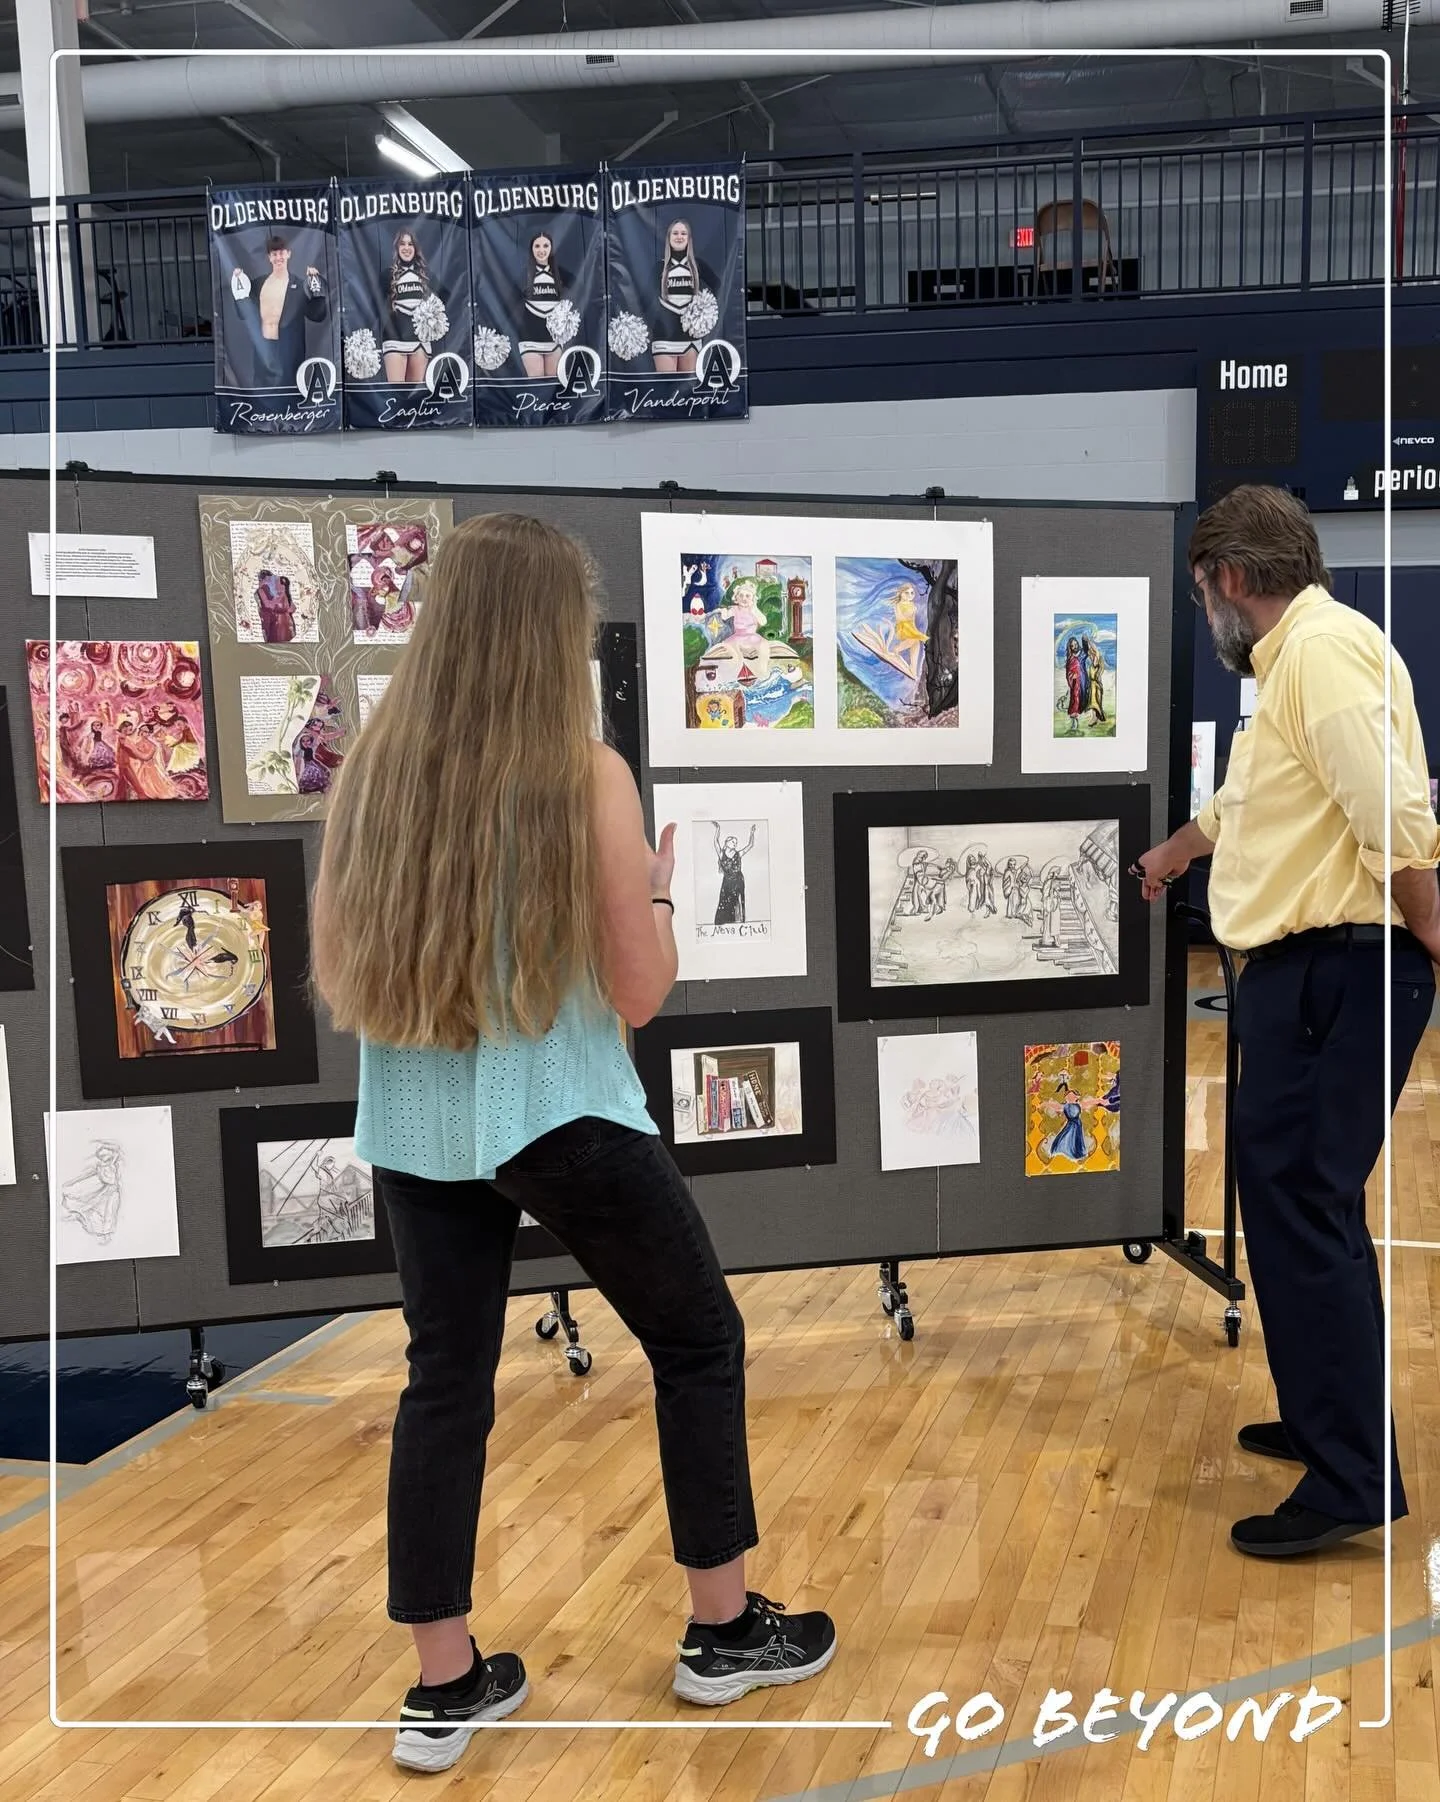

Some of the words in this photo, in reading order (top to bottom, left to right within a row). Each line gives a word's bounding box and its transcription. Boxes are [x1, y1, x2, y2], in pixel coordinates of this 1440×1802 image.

[340, 190, 464, 224] OLDENBURG
[474, 182, 599, 218] OLDENBURG
[611, 174, 741, 211] OLDENBURG
[211, 197, 329, 231] OLDENBURG
[1220, 360, 1288, 390] Home
[229, 402, 330, 431] Rosenberger
[378, 398, 441, 430] Eaglin
[512, 392, 572, 418] Pierce
[624, 388, 729, 416] Vanderpohl
[1374, 464, 1440, 498] perio
